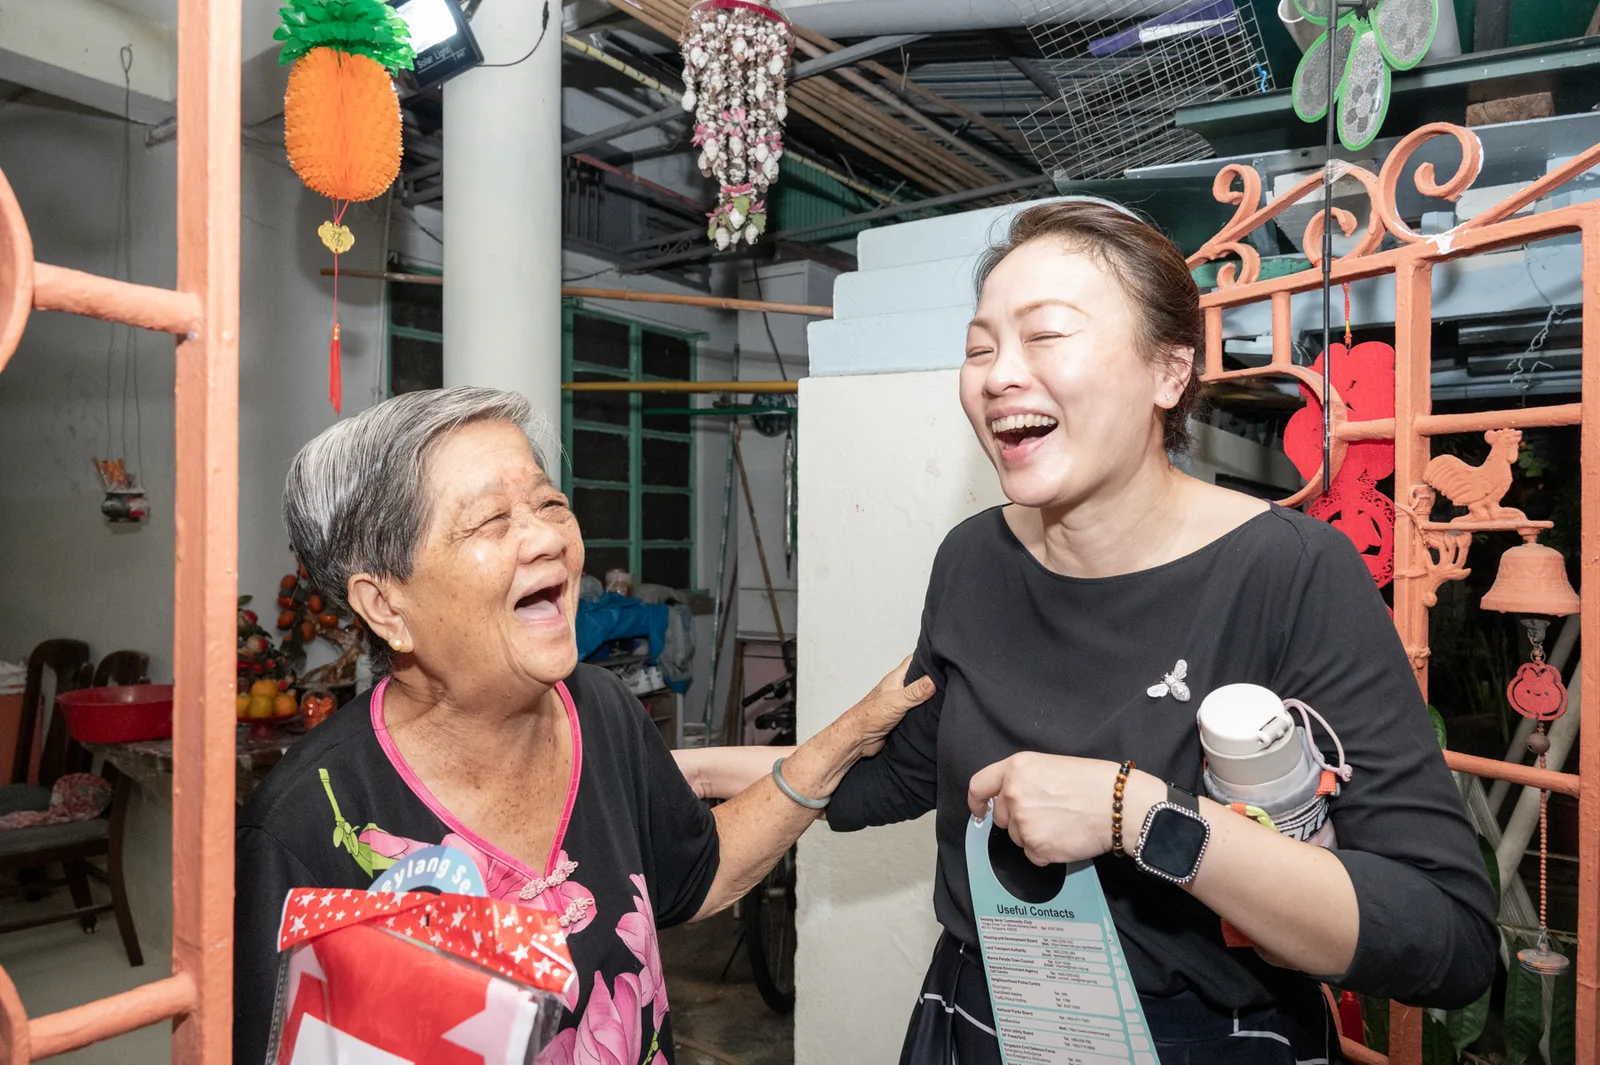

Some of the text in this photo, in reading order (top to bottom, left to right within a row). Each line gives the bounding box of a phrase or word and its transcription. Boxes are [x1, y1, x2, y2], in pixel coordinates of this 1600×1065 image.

[417, 56, 433, 68] Solar
[381, 857, 451, 893] eylang
[997, 904, 1075, 918] Useful Contacts
